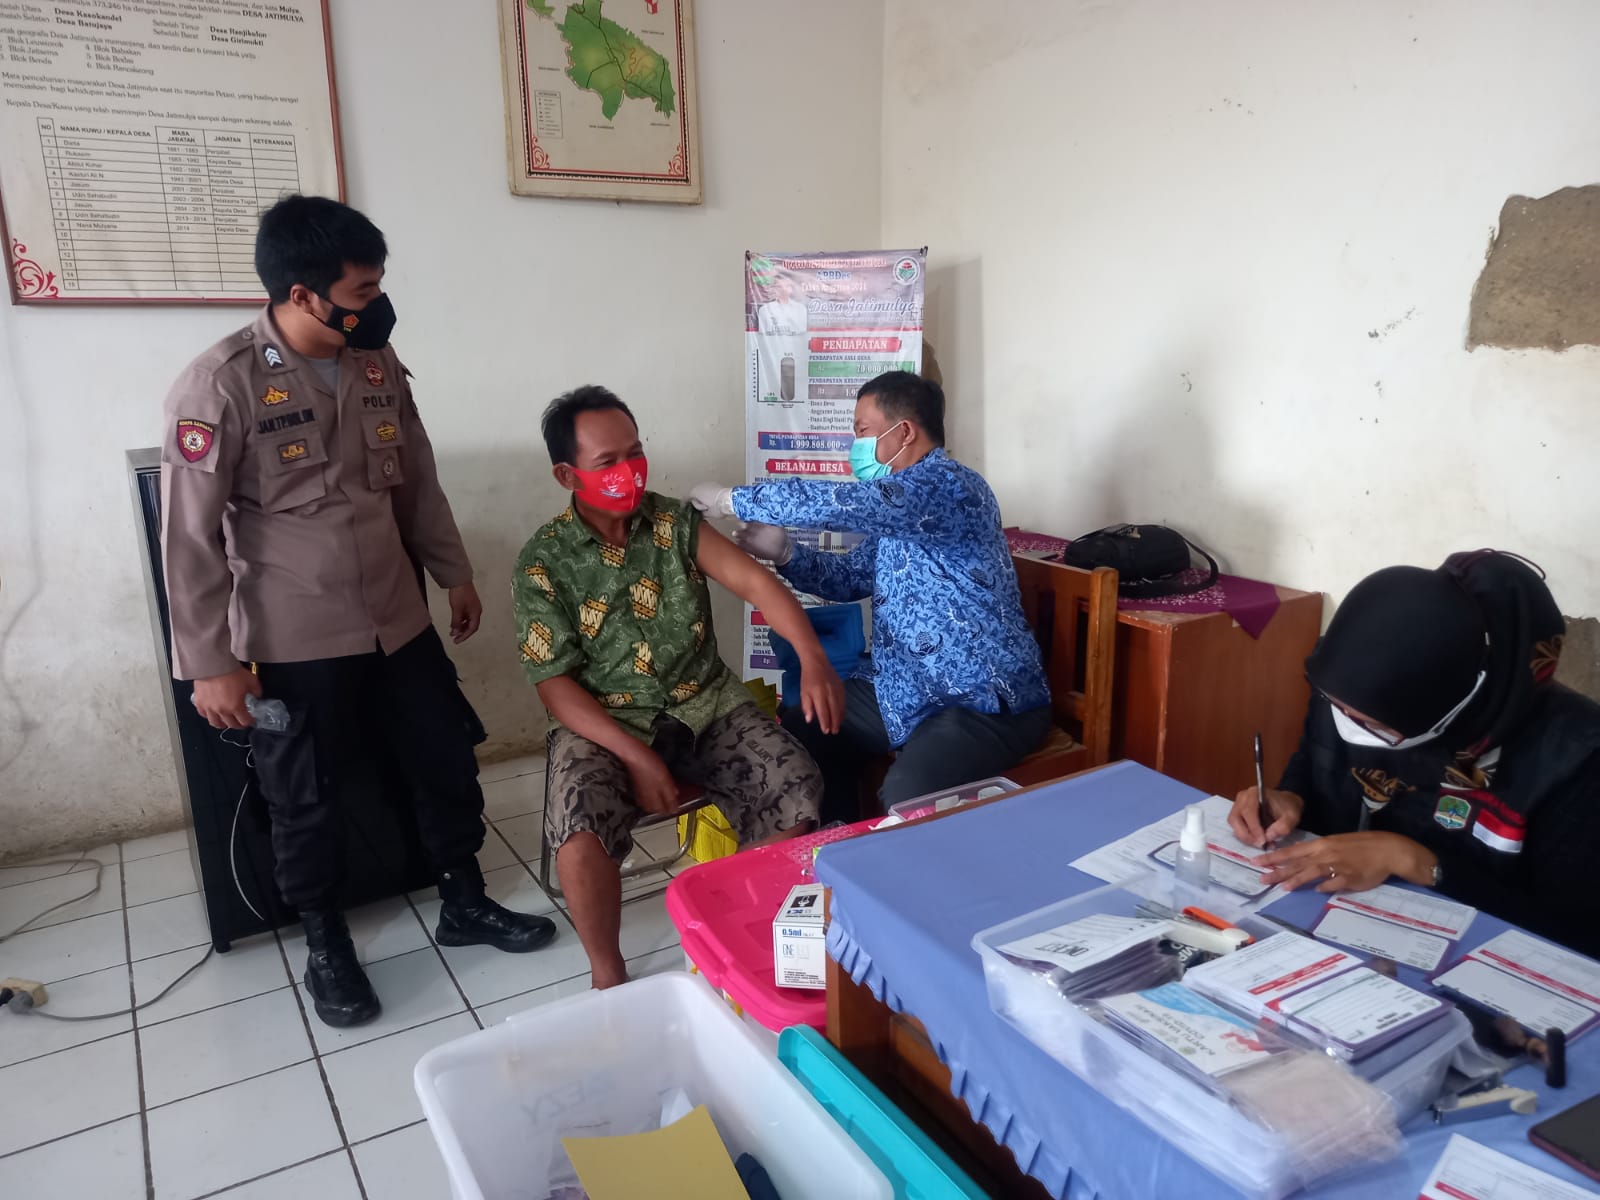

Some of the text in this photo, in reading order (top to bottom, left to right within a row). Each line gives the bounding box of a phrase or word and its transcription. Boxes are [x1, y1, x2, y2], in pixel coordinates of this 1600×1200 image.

[54, 8, 74, 16] Desa
[242, 10, 262, 18] DESA
[265, 12, 304, 22] JATIMULYA
[56, 16, 76, 26] Desa
[210, 26, 228, 34] Desa
[211, 34, 228, 42] Desa
[822, 340, 889, 350] PENDAPATAN
[775, 462, 844, 472] BELANJA DESA
[782, 928, 802, 936] 0.5ml
